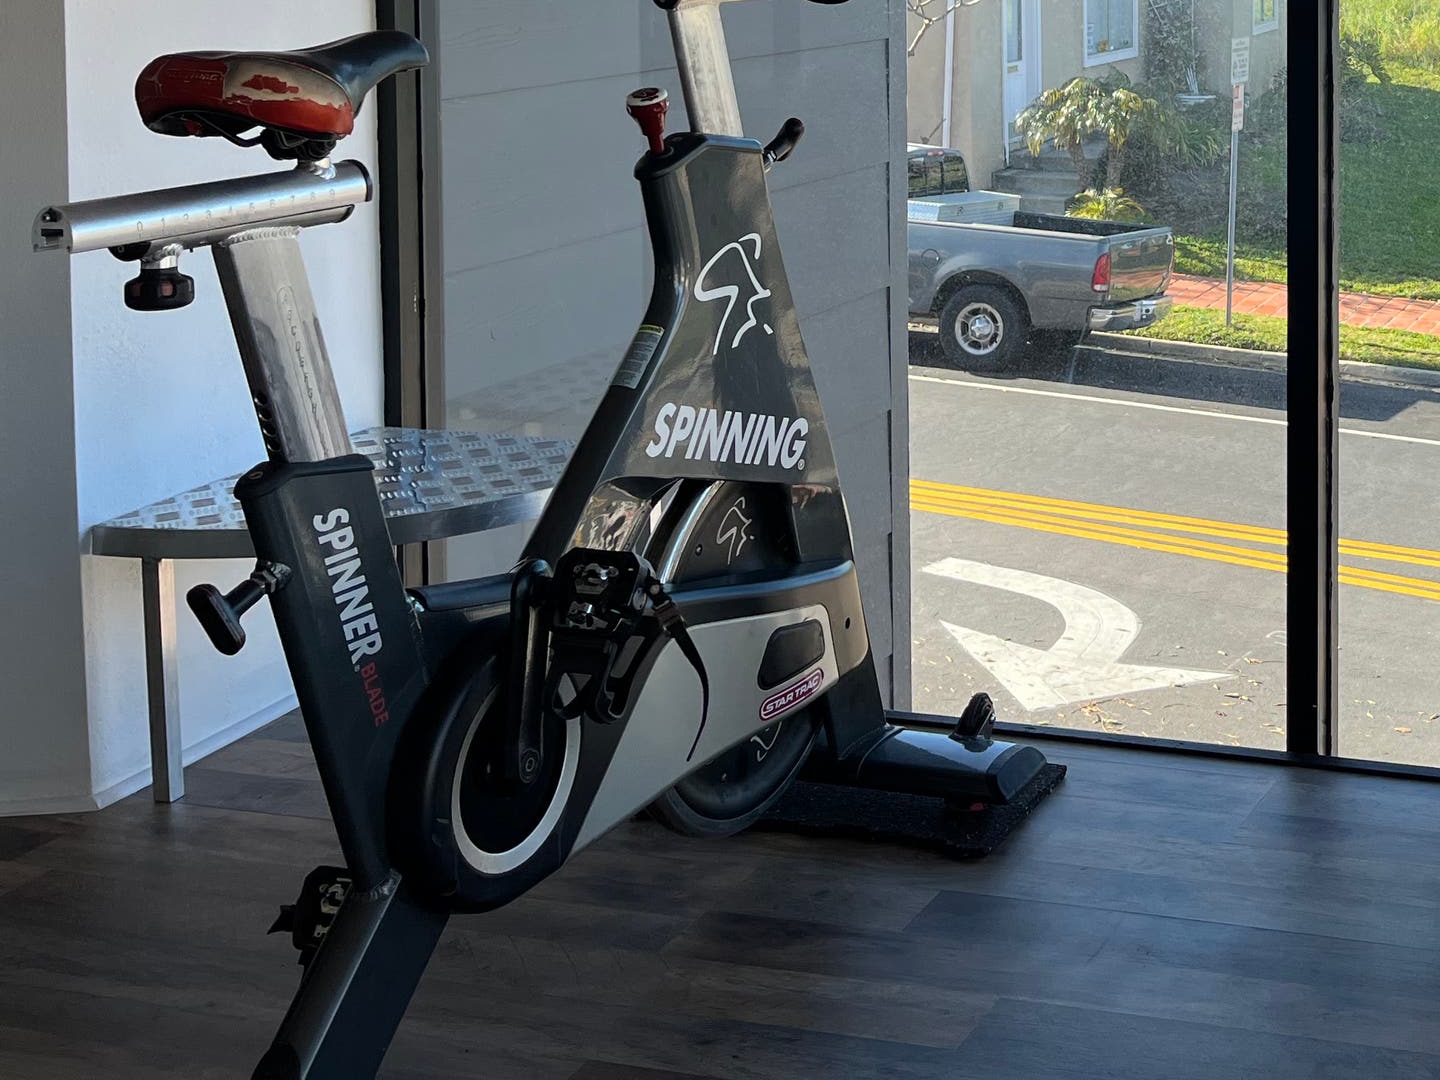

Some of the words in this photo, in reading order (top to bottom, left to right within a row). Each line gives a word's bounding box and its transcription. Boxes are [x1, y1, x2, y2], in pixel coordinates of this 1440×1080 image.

[645, 402, 809, 470] SPINNING
[312, 506, 383, 666] SPINNER
[360, 662, 390, 728] BLADE
[765, 693, 794, 712] STAR
[794, 675, 820, 698] TRAC
